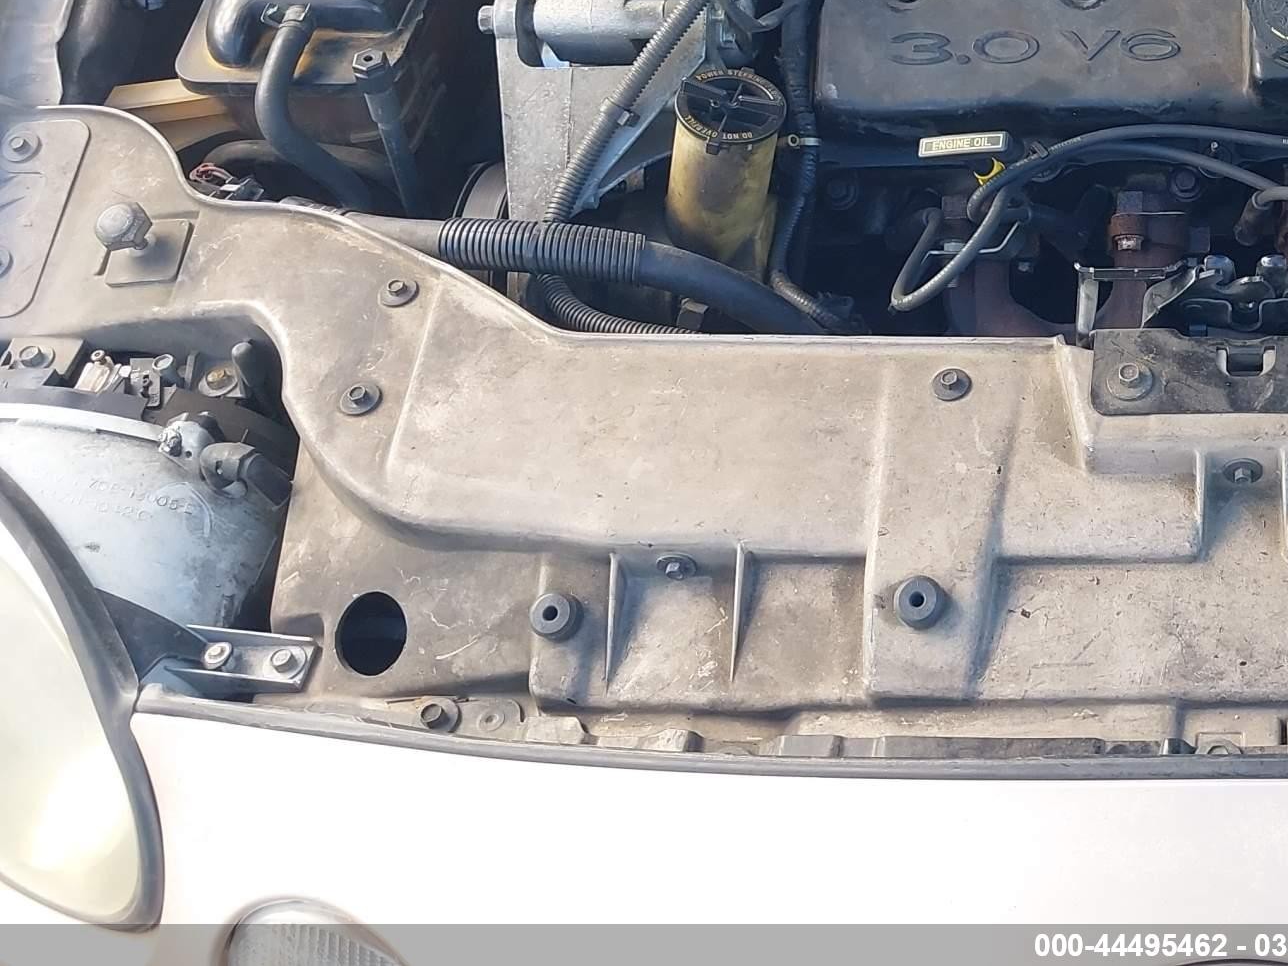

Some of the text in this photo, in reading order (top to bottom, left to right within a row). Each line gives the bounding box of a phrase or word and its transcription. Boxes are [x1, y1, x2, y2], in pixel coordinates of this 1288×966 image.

[889, 29, 1182, 65] 3.0 V6
[932, 137, 992, 151] ENGINE OIL
